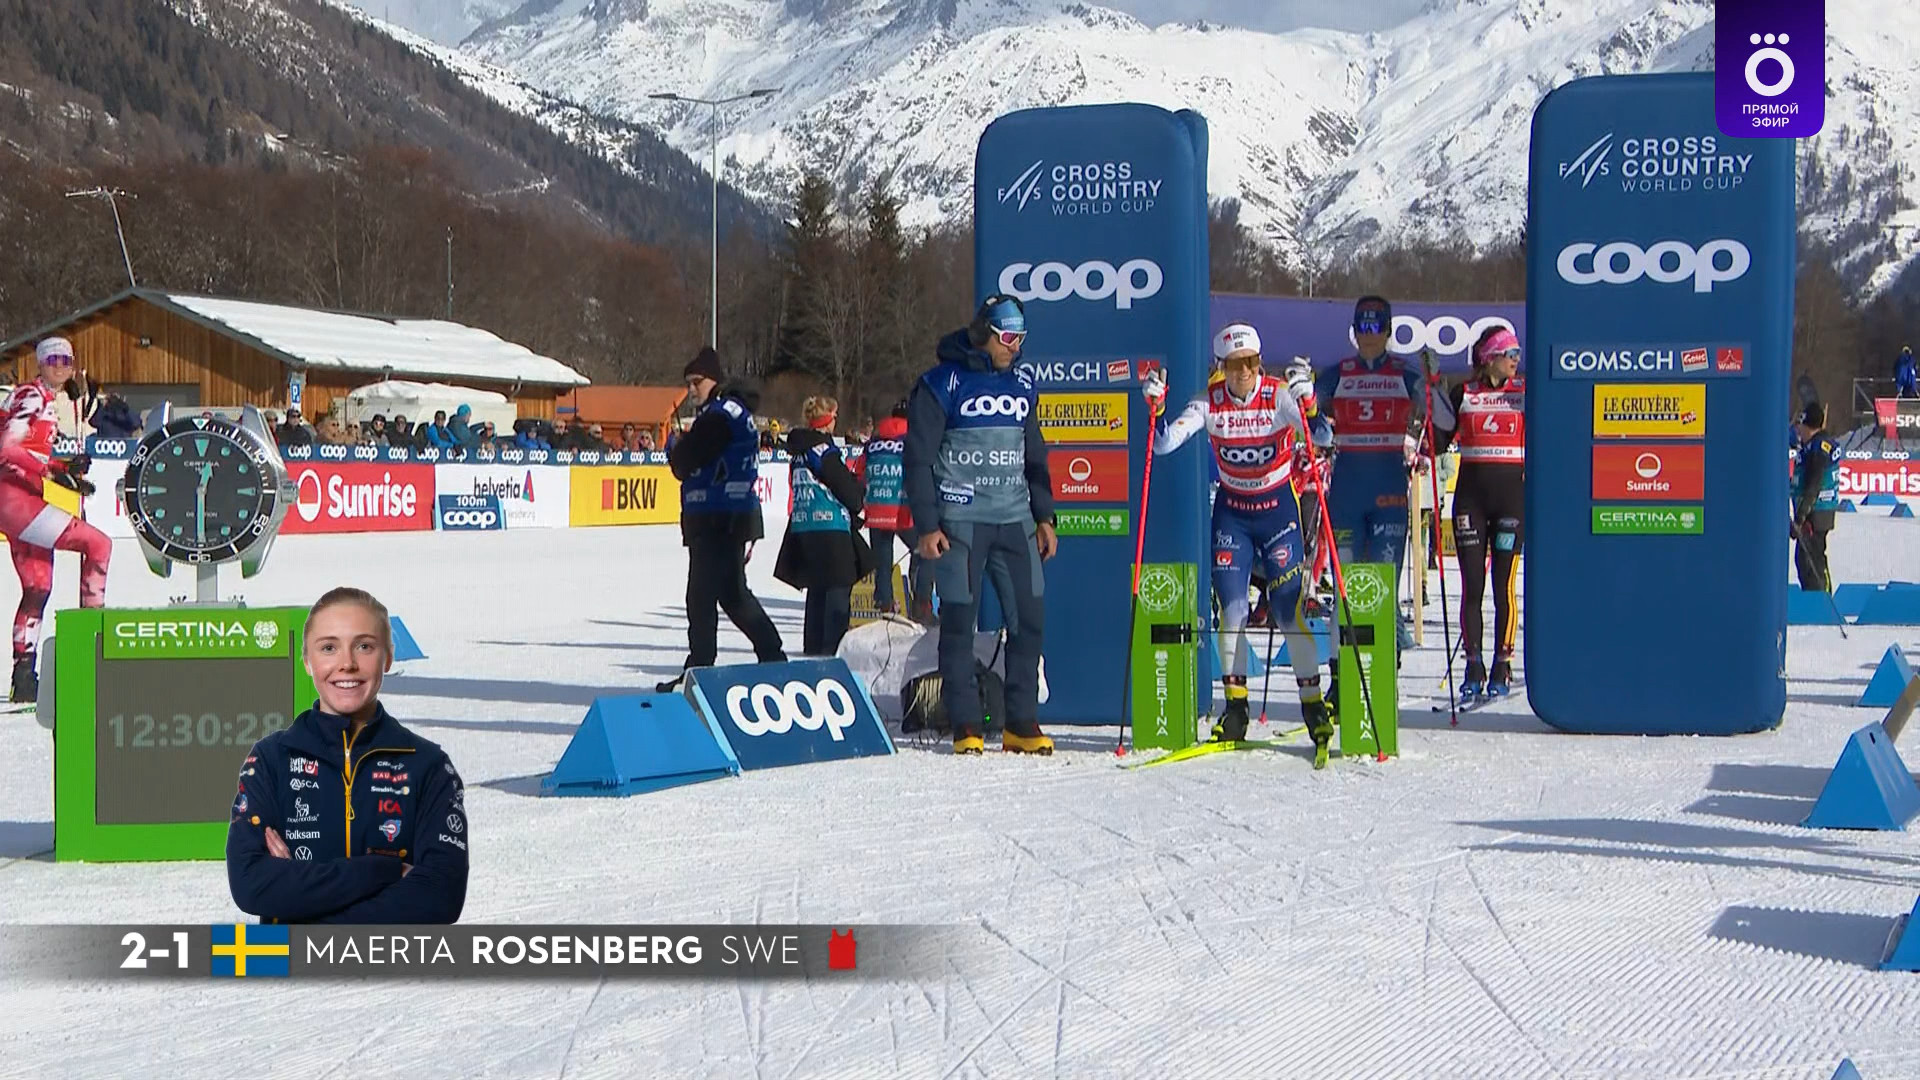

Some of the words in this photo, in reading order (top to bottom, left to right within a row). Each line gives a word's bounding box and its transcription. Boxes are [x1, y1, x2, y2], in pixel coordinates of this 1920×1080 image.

[1622, 136, 1717, 157] CROSS
[1051, 162, 1131, 182] CROSS
[1622, 154, 1753, 178] COUNTRY
[1051, 180, 1162, 201] COUNTRY
[1622, 178, 1691, 193] WORLD
[1703, 176, 1743, 190] CUP
[1052, 201, 1112, 215] WORLD
[1121, 200, 1155, 212] CUP
[1557, 239, 1751, 293] coop
[998, 259, 1164, 309] coop
[1559, 351, 1674, 371] GOMS.CH
[1717, 362, 1741, 370] Wallis
[1357, 379, 1399, 390] Sunrise
[960, 395, 1029, 422] coop
[1040, 404, 1052, 418] LE
[1055, 400, 1107, 418] GRUYÈRE
[1358, 400, 1374, 421] 3
[1604, 397, 1618, 412] LE
[1621, 394, 1680, 412] GRUYÈRE
[1228, 415, 1272, 427] Sunrise
[1482, 414, 1499, 433] 4
[1509, 423, 1515, 433] 1
[95, 441, 126, 457] coop
[288, 444, 311, 460] coop
[320, 445, 347, 460] coop
[355, 445, 378, 461] coop
[388, 447, 408, 462] coop
[502, 450, 523, 464] coop
[529, 450, 548, 464] coop
[580, 451, 600, 465] coop
[630, 452, 645, 464] coop
[948, 450, 983, 465] LOC
[1220, 446, 1274, 463] coop
[1846, 450, 1872, 461] coop
[1882, 451, 1909, 462] coop
[867, 465, 903, 477] TEAM
[474, 476, 520, 499] helvetia
[1061, 483, 1099, 493] Sunrise
[1627, 480, 1670, 491] Sunrise
[328, 472, 416, 518] Sunrise
[457, 496, 487, 507] 100m
[617, 479, 657, 510] BKW
[944, 494, 968, 504] coop
[1227, 499, 1279, 510] BAUHAUS
[443, 511, 496, 528] coop
[1600, 512, 1677, 521] CERTINA
[188, 553, 211, 562] 30
[115, 622, 248, 638] CERTINA
[118, 640, 166, 648] SWISS
[176, 640, 246, 648] WATCHES
[726, 678, 856, 742] coop
[1156, 668, 1168, 736] CERTINA
